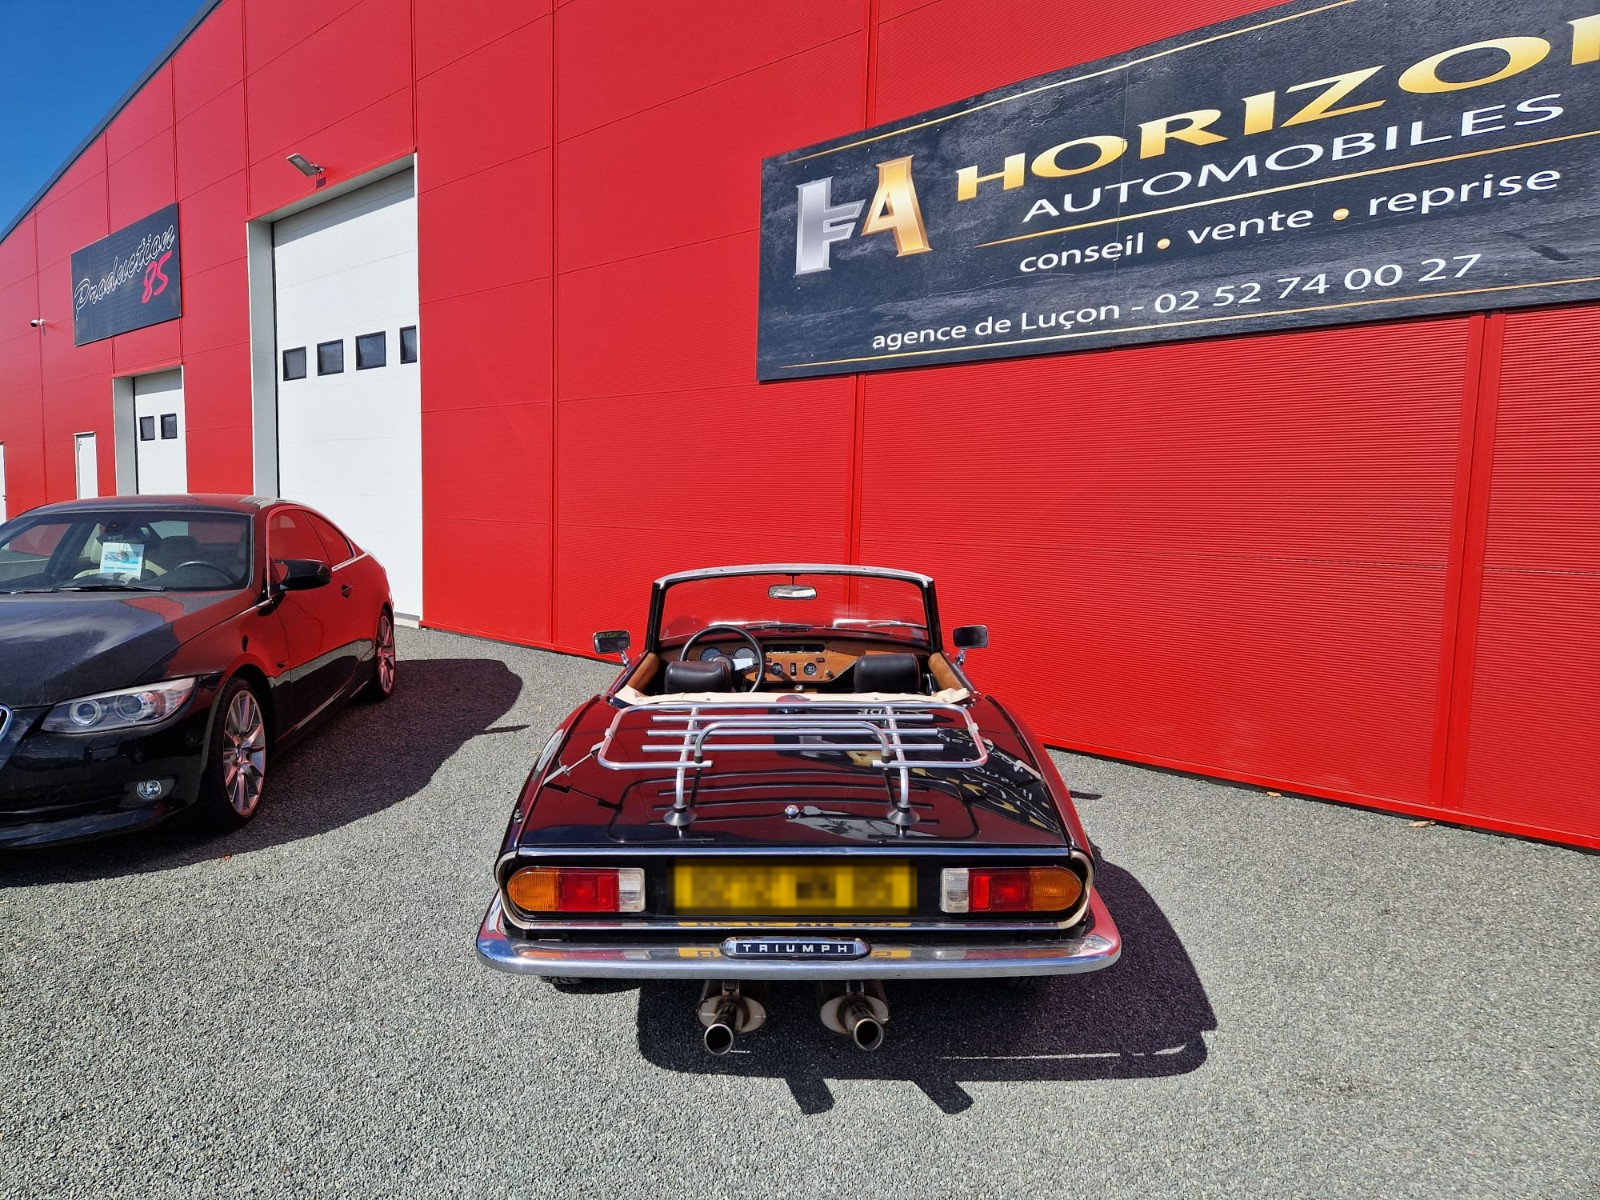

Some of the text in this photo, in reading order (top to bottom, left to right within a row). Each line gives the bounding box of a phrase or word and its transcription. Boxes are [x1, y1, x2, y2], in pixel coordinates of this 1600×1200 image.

[1022, 93, 1564, 223] AUTOMOBILES
[1019, 169, 1561, 272] conseil vente reprise
[74, 225, 175, 320] Production
[872, 322, 967, 350] agence
[974, 316, 1012, 336] de
[1020, 304, 1120, 331] Luçon
[1154, 291, 1200, 313] 02
[1212, 283, 1262, 308] 52
[1277, 273, 1330, 299] 74
[1343, 264, 1402, 290] 00
[1417, 254, 1482, 282] 27
[743, 943, 848, 953] TRIUMPH
